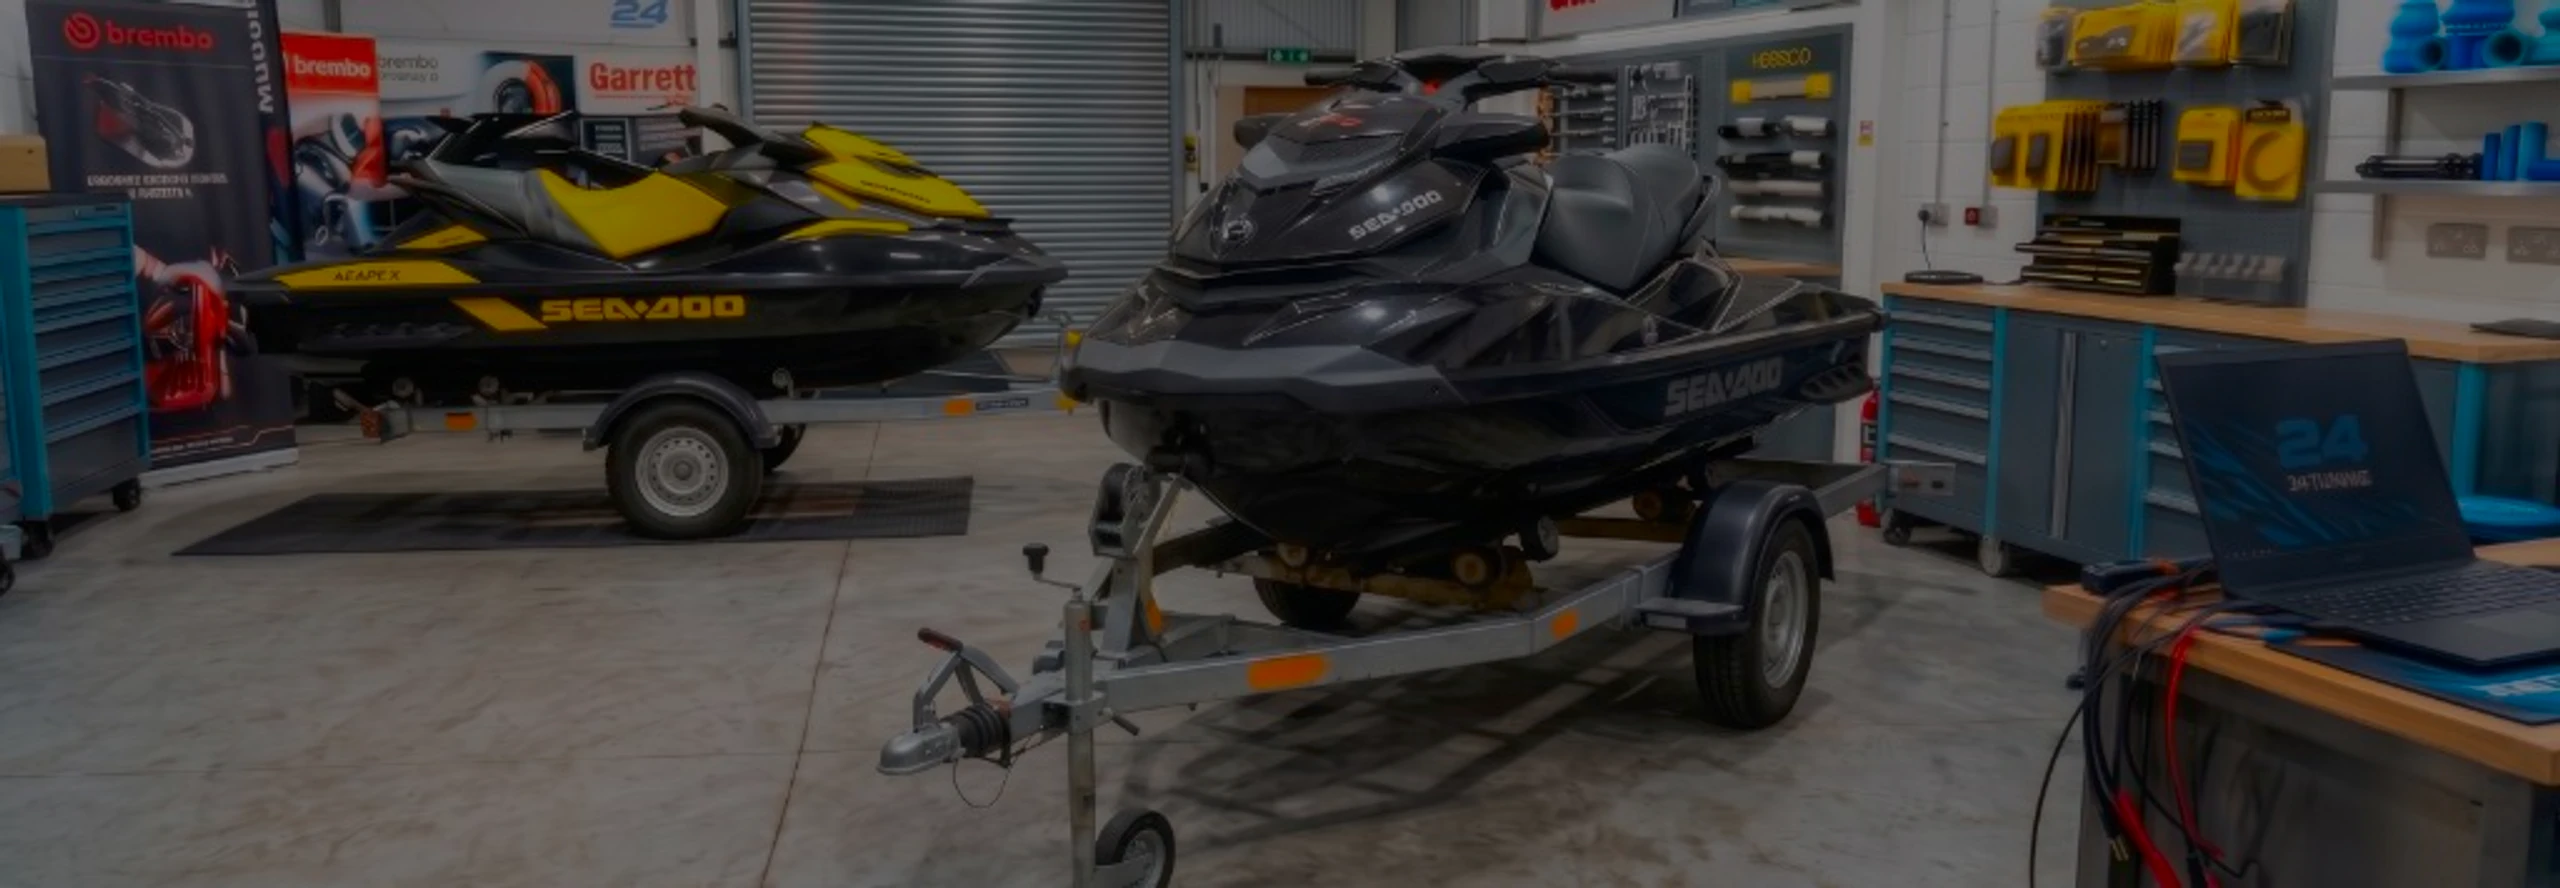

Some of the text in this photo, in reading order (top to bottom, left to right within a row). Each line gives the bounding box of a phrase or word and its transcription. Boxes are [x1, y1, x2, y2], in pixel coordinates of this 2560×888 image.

[105, 20, 214, 49] brembo
[294, 53, 372, 78] brembo
[590, 62, 696, 91] Garrett
[2276, 414, 2368, 469] 24
